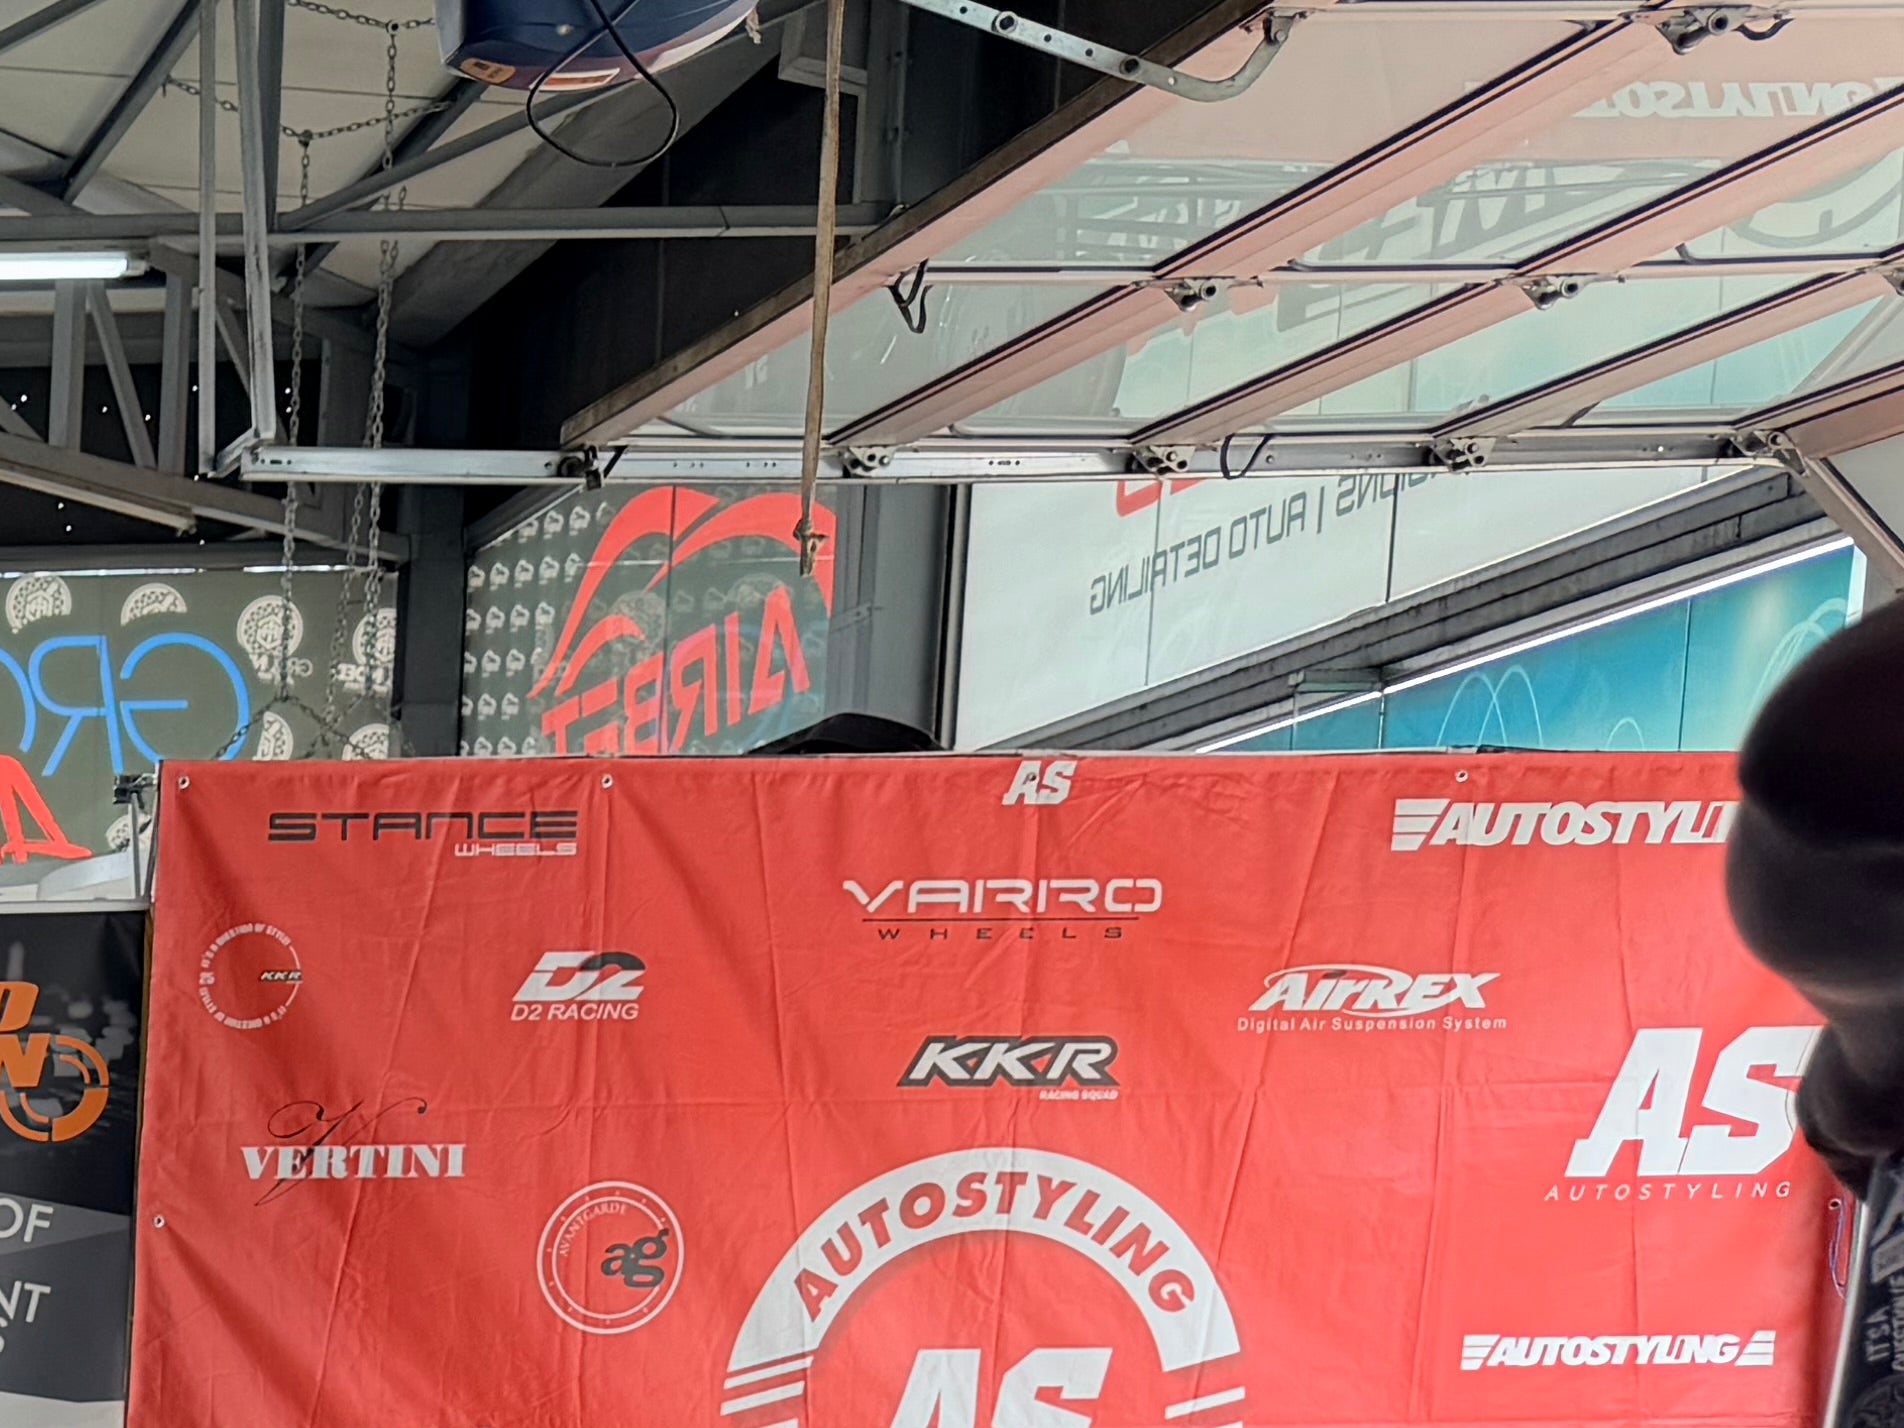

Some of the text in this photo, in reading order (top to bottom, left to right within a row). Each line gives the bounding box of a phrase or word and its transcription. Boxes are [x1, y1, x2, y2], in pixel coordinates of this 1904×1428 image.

[268, 811, 578, 841] STANCE
[511, 1003, 639, 1021] D2 RACING
[1237, 1016, 1506, 1033] Digital Air Suspension System
[903, 1039, 1117, 1084] KKR
[241, 1143, 466, 1180] VERTINI
[1544, 1182, 1791, 1201] AUTOSTYLING
[559, 1202, 627, 1257] AVANTGARDE
[793, 1171, 1195, 1322] AUTOSTYLING
